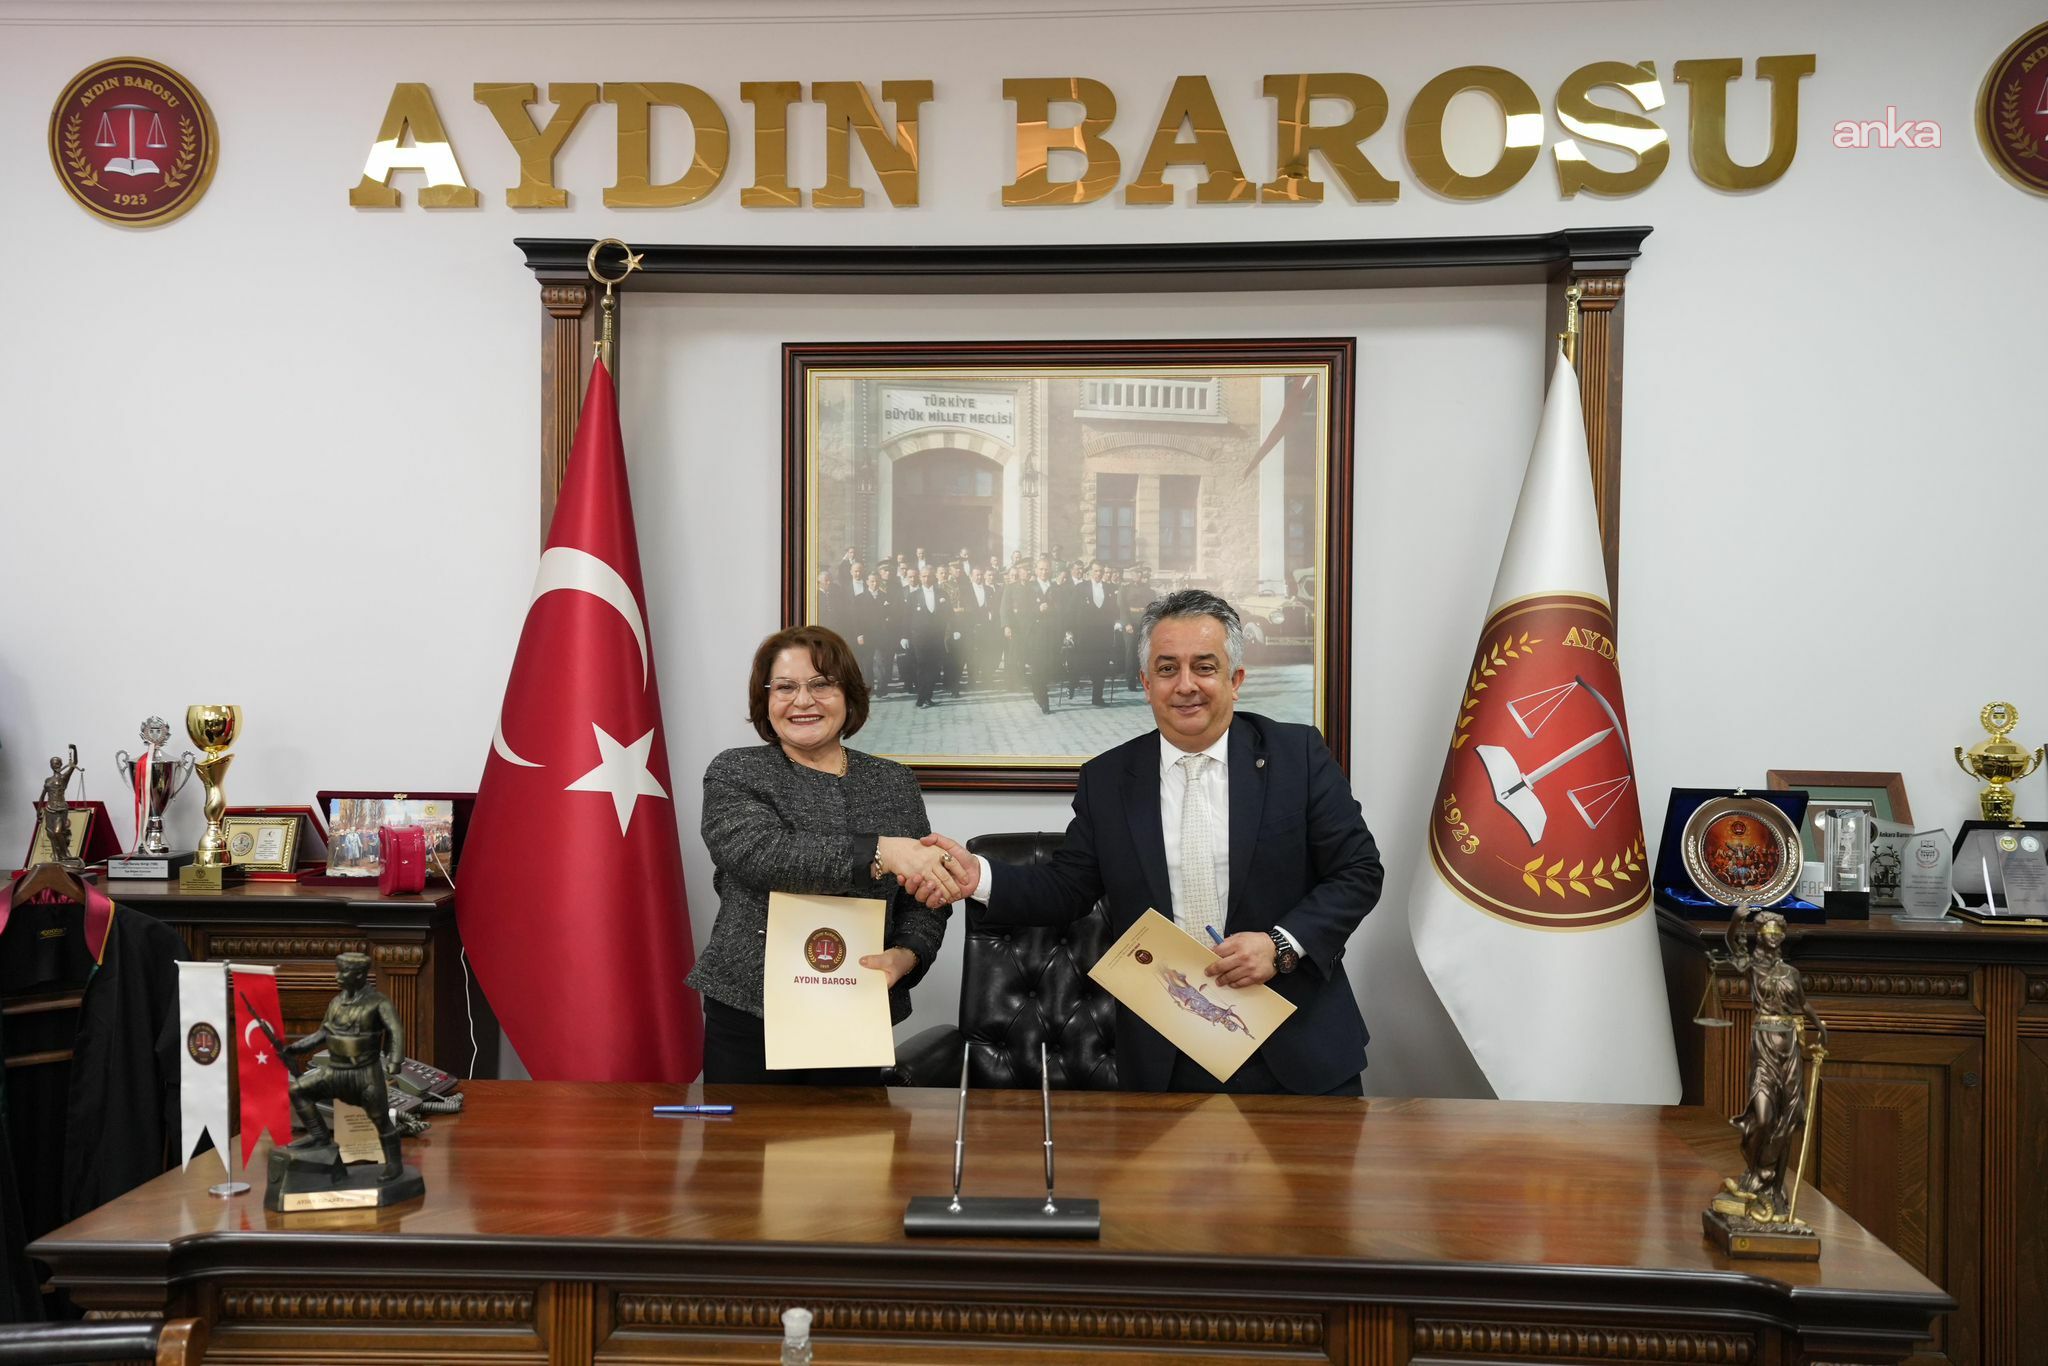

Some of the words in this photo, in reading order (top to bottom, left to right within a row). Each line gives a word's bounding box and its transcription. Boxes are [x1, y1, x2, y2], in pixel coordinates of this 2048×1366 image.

[79, 77, 120, 108] AYDIN
[123, 75, 180, 108] BAROSU
[348, 80, 934, 208] AYDIN
[1001, 54, 1817, 206] BAROSU
[113, 193, 148, 206] 1923
[923, 394, 976, 408] TÜRKİYE
[884, 408, 924, 420] BÜYÜK
[928, 410, 966, 423] MİLLET
[969, 412, 1013, 425] MECLİSİ
[1562, 626, 1620, 673] AYD
[1444, 793, 1480, 854] 1923
[793, 975, 820, 985] AYDIN
[822, 977, 857, 985] BAROSU
